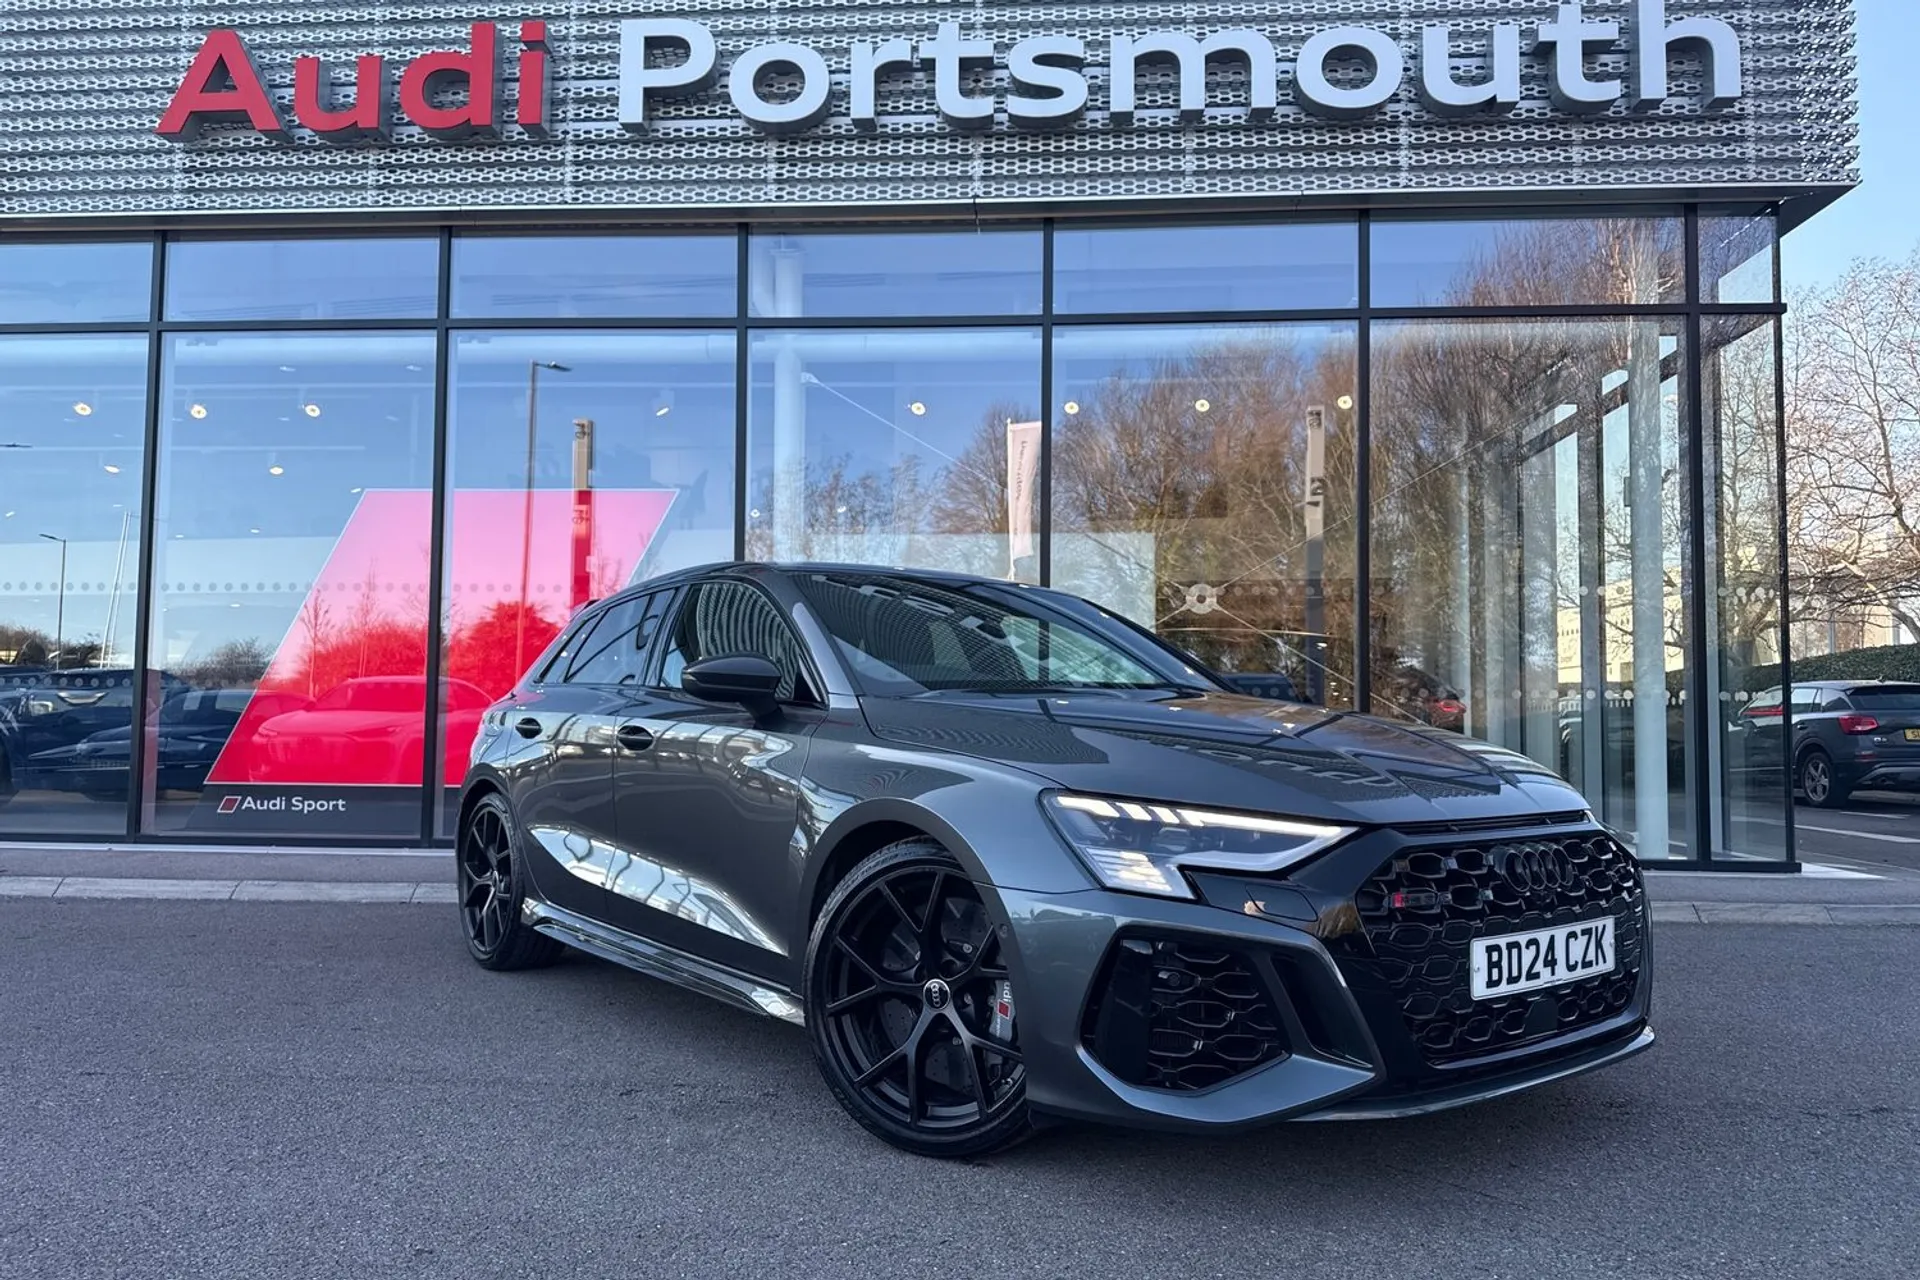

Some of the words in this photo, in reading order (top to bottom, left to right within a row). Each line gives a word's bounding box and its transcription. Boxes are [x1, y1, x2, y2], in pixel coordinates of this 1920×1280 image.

[153, 20, 547, 134] Audi
[617, 0, 1742, 123] Portsmouth
[241, 796, 286, 811] Audi
[291, 796, 346, 815] Sport
[1485, 934, 1558, 989] BD24
[1565, 923, 1607, 973] CZK
